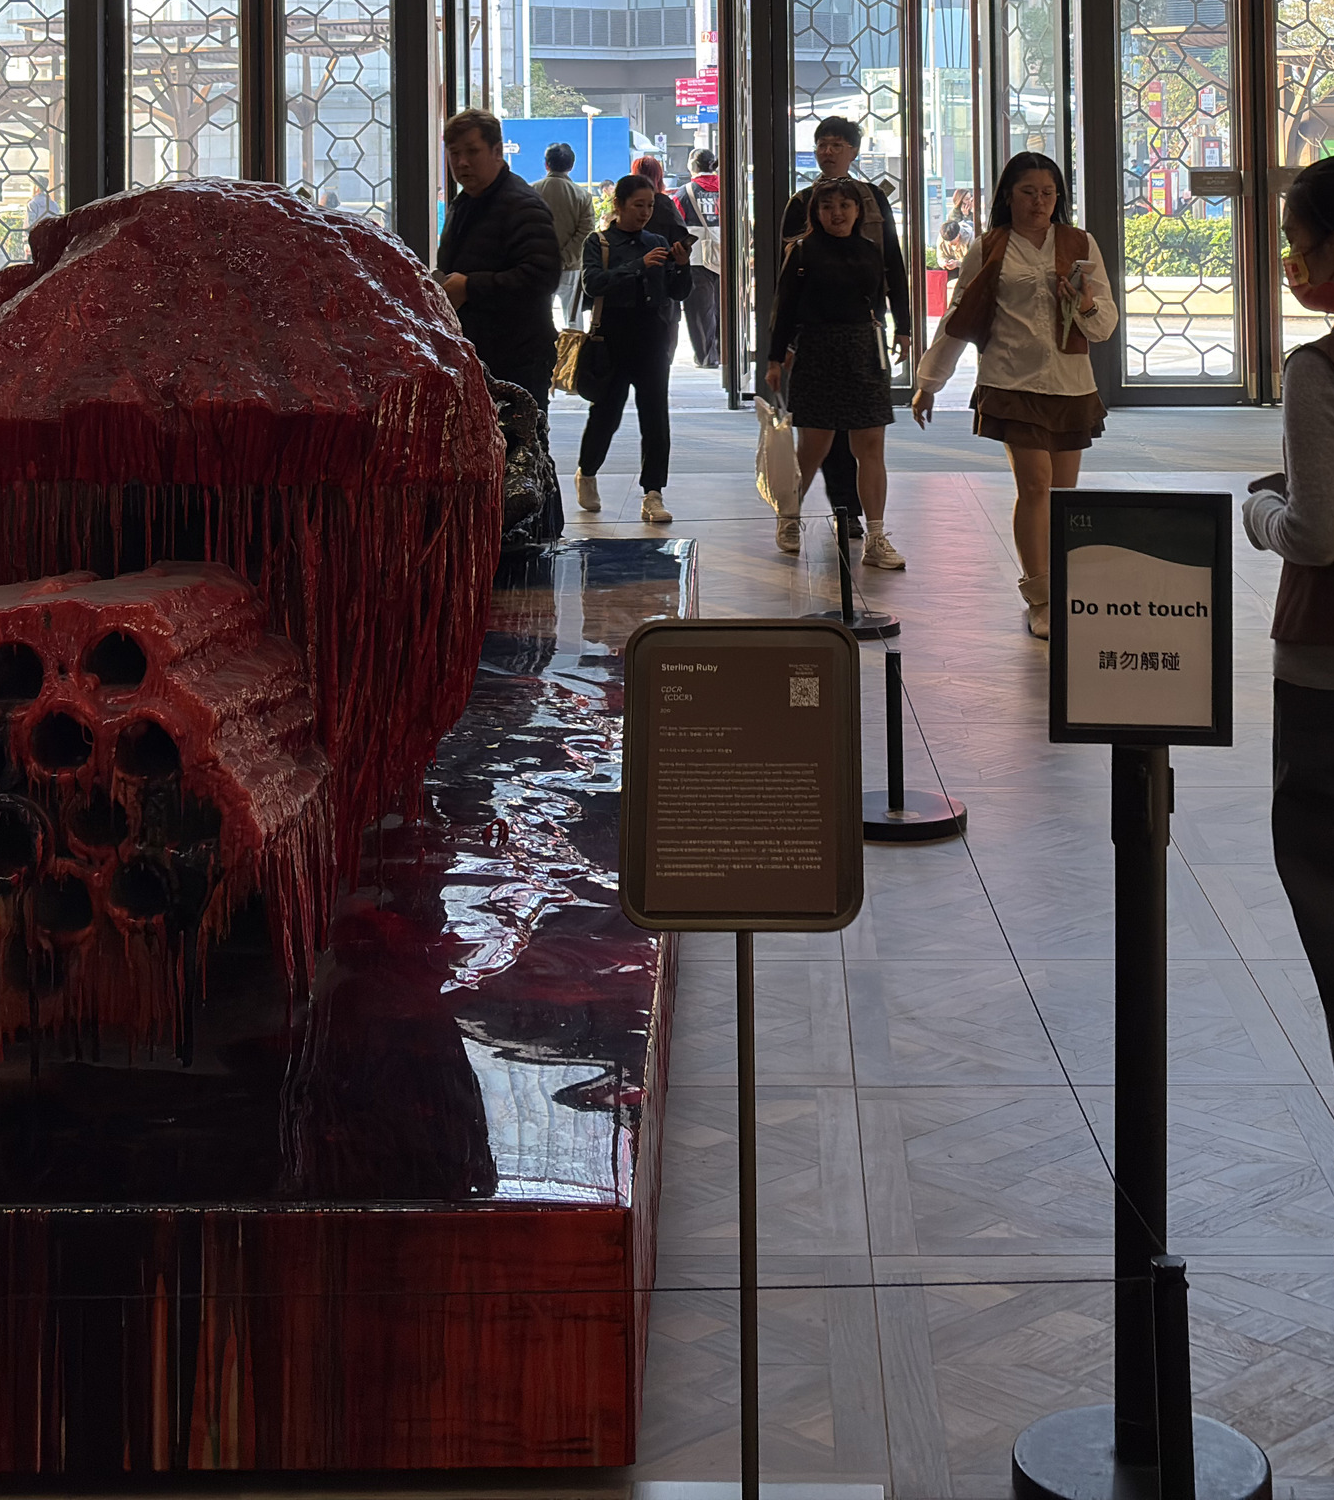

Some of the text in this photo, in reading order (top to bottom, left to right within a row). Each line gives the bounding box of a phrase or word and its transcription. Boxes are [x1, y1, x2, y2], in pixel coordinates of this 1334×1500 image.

[1069, 514, 1093, 528] K11
[1071, 599, 1208, 618] Do not touch
[661, 663, 718, 673] Sterling Ruby
[1098, 650, 1181, 671] 請勿觸碰
